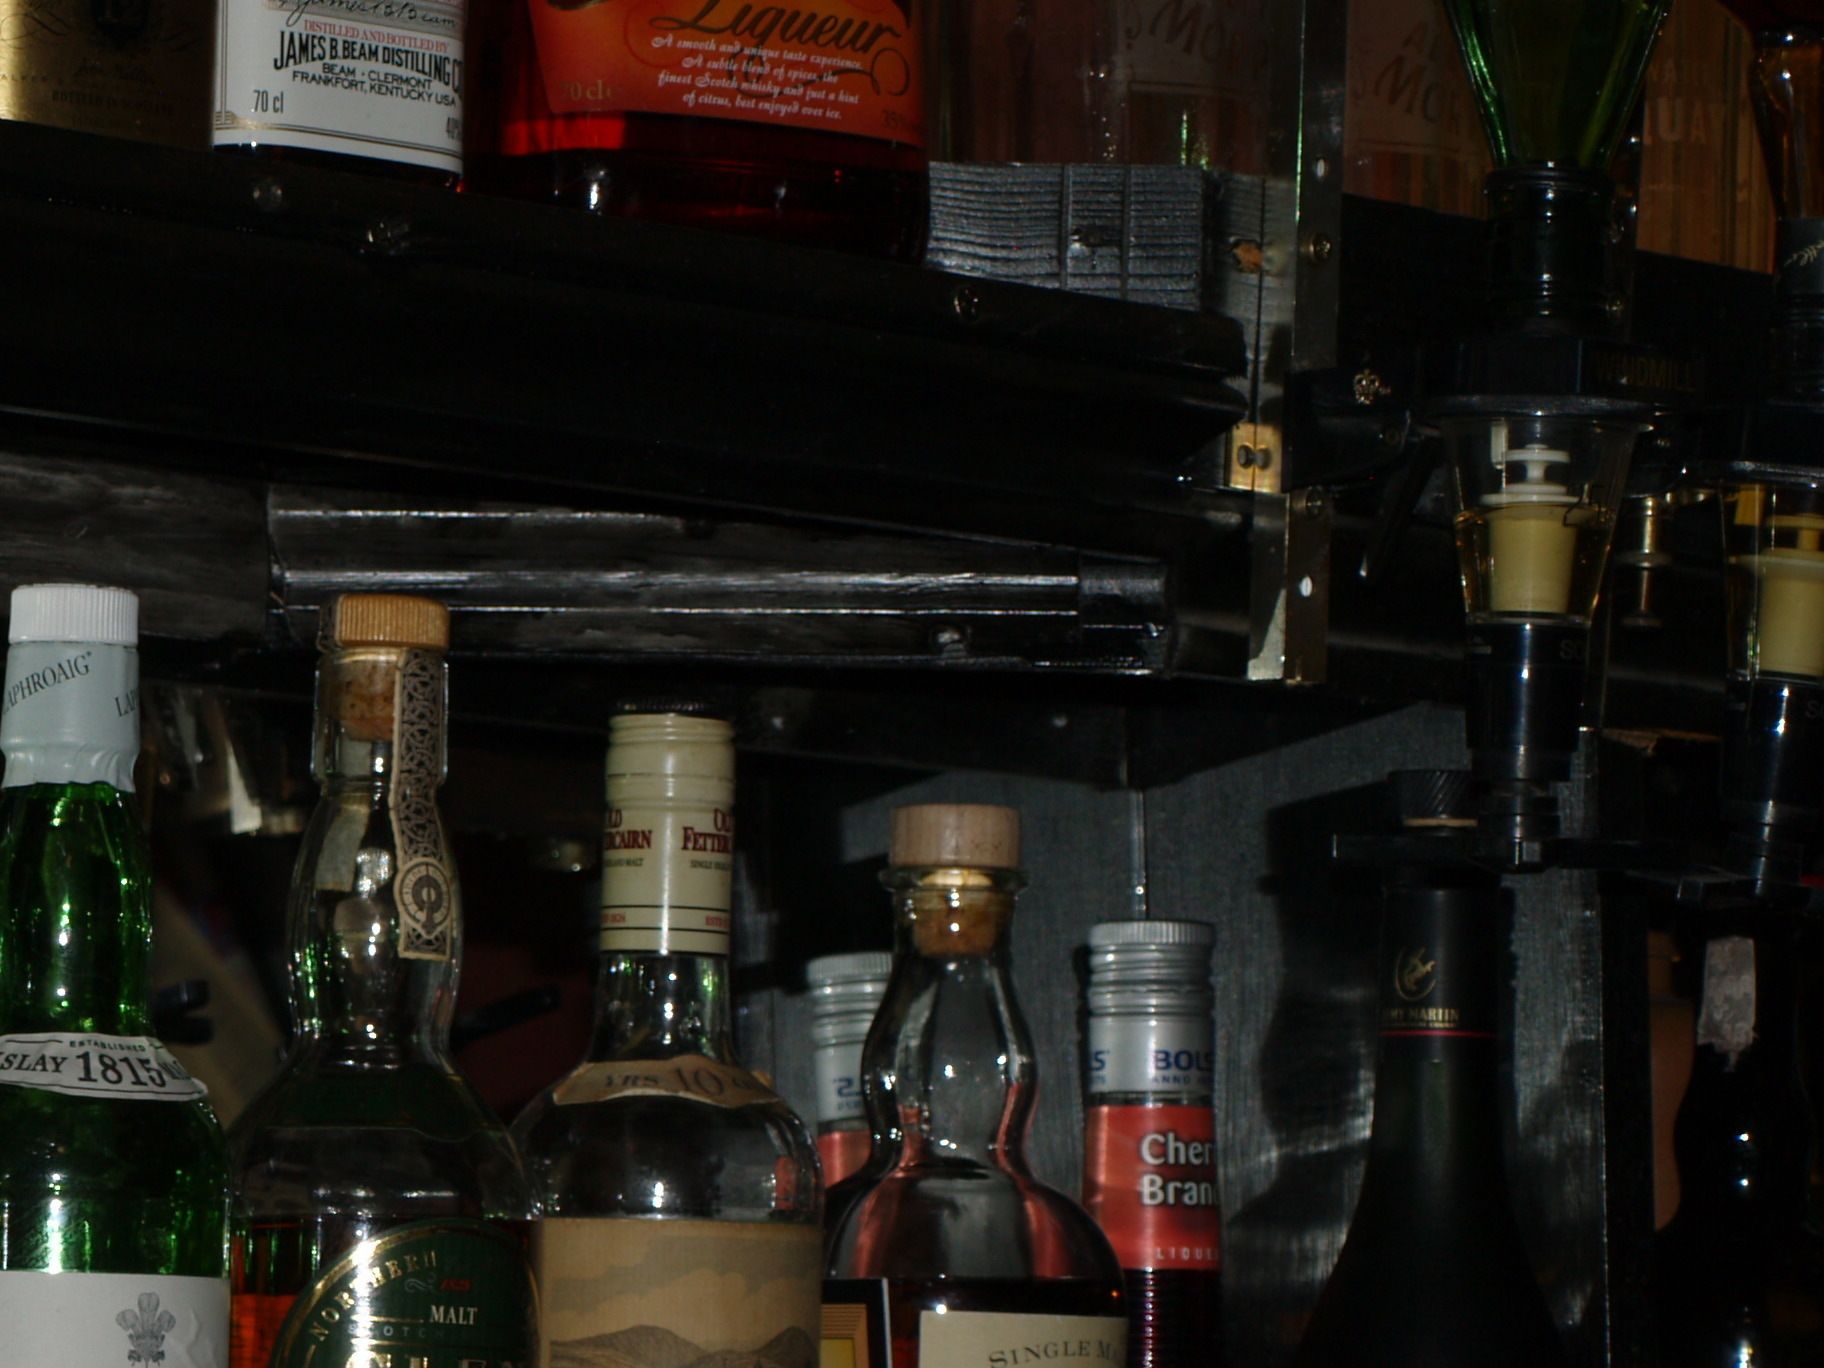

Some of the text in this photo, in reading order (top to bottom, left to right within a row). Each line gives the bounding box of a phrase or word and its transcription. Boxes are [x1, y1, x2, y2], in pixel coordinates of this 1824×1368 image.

[649, 0, 901, 51] Liqueur
[273, 30, 450, 85] JAMES B. BEAM DISTILLING
[292, 71, 456, 107] FRANKFORT, KENTUCKY USA
[322, 62, 432, 90] BEAM CLERMONT
[253, 90, 284, 113] 70 cl
[429, 1305, 477, 1325] MALT
